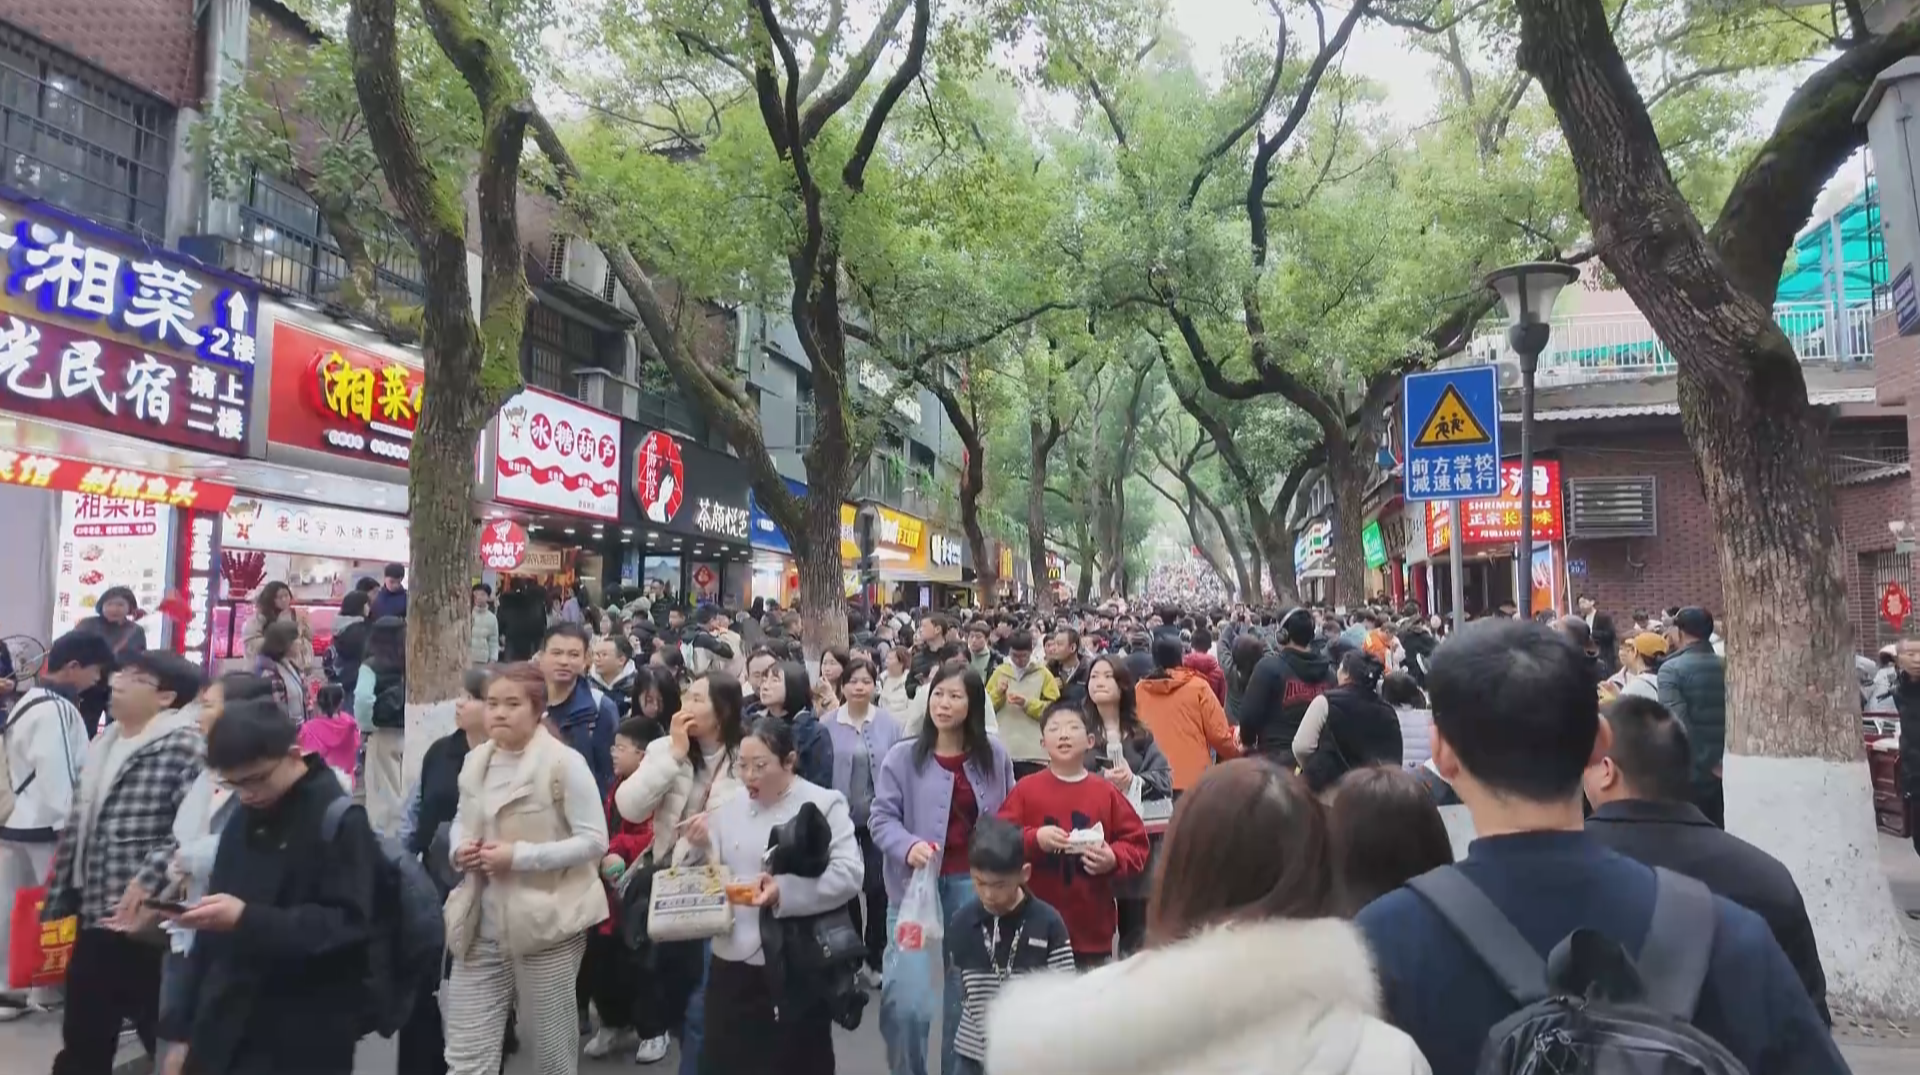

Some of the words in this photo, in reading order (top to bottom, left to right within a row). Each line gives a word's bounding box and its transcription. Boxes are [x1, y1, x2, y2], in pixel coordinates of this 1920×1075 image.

[209, 327, 256, 364] 2楼
[188, 365, 245, 406] 请上
[323, 351, 422, 421] 湘菜
[187, 403, 244, 441] 二楼
[529, 413, 617, 468] 冰糖葫芦
[1411, 453, 1494, 476] 前方学校
[1501, 465, 1550, 497] 滑
[1412, 473, 1495, 494] 减速慢行
[1468, 500, 1513, 511] SHRIMP
[1513, 499, 1552, 510] BLLS
[1468, 510, 1553, 526] 正宗长味
